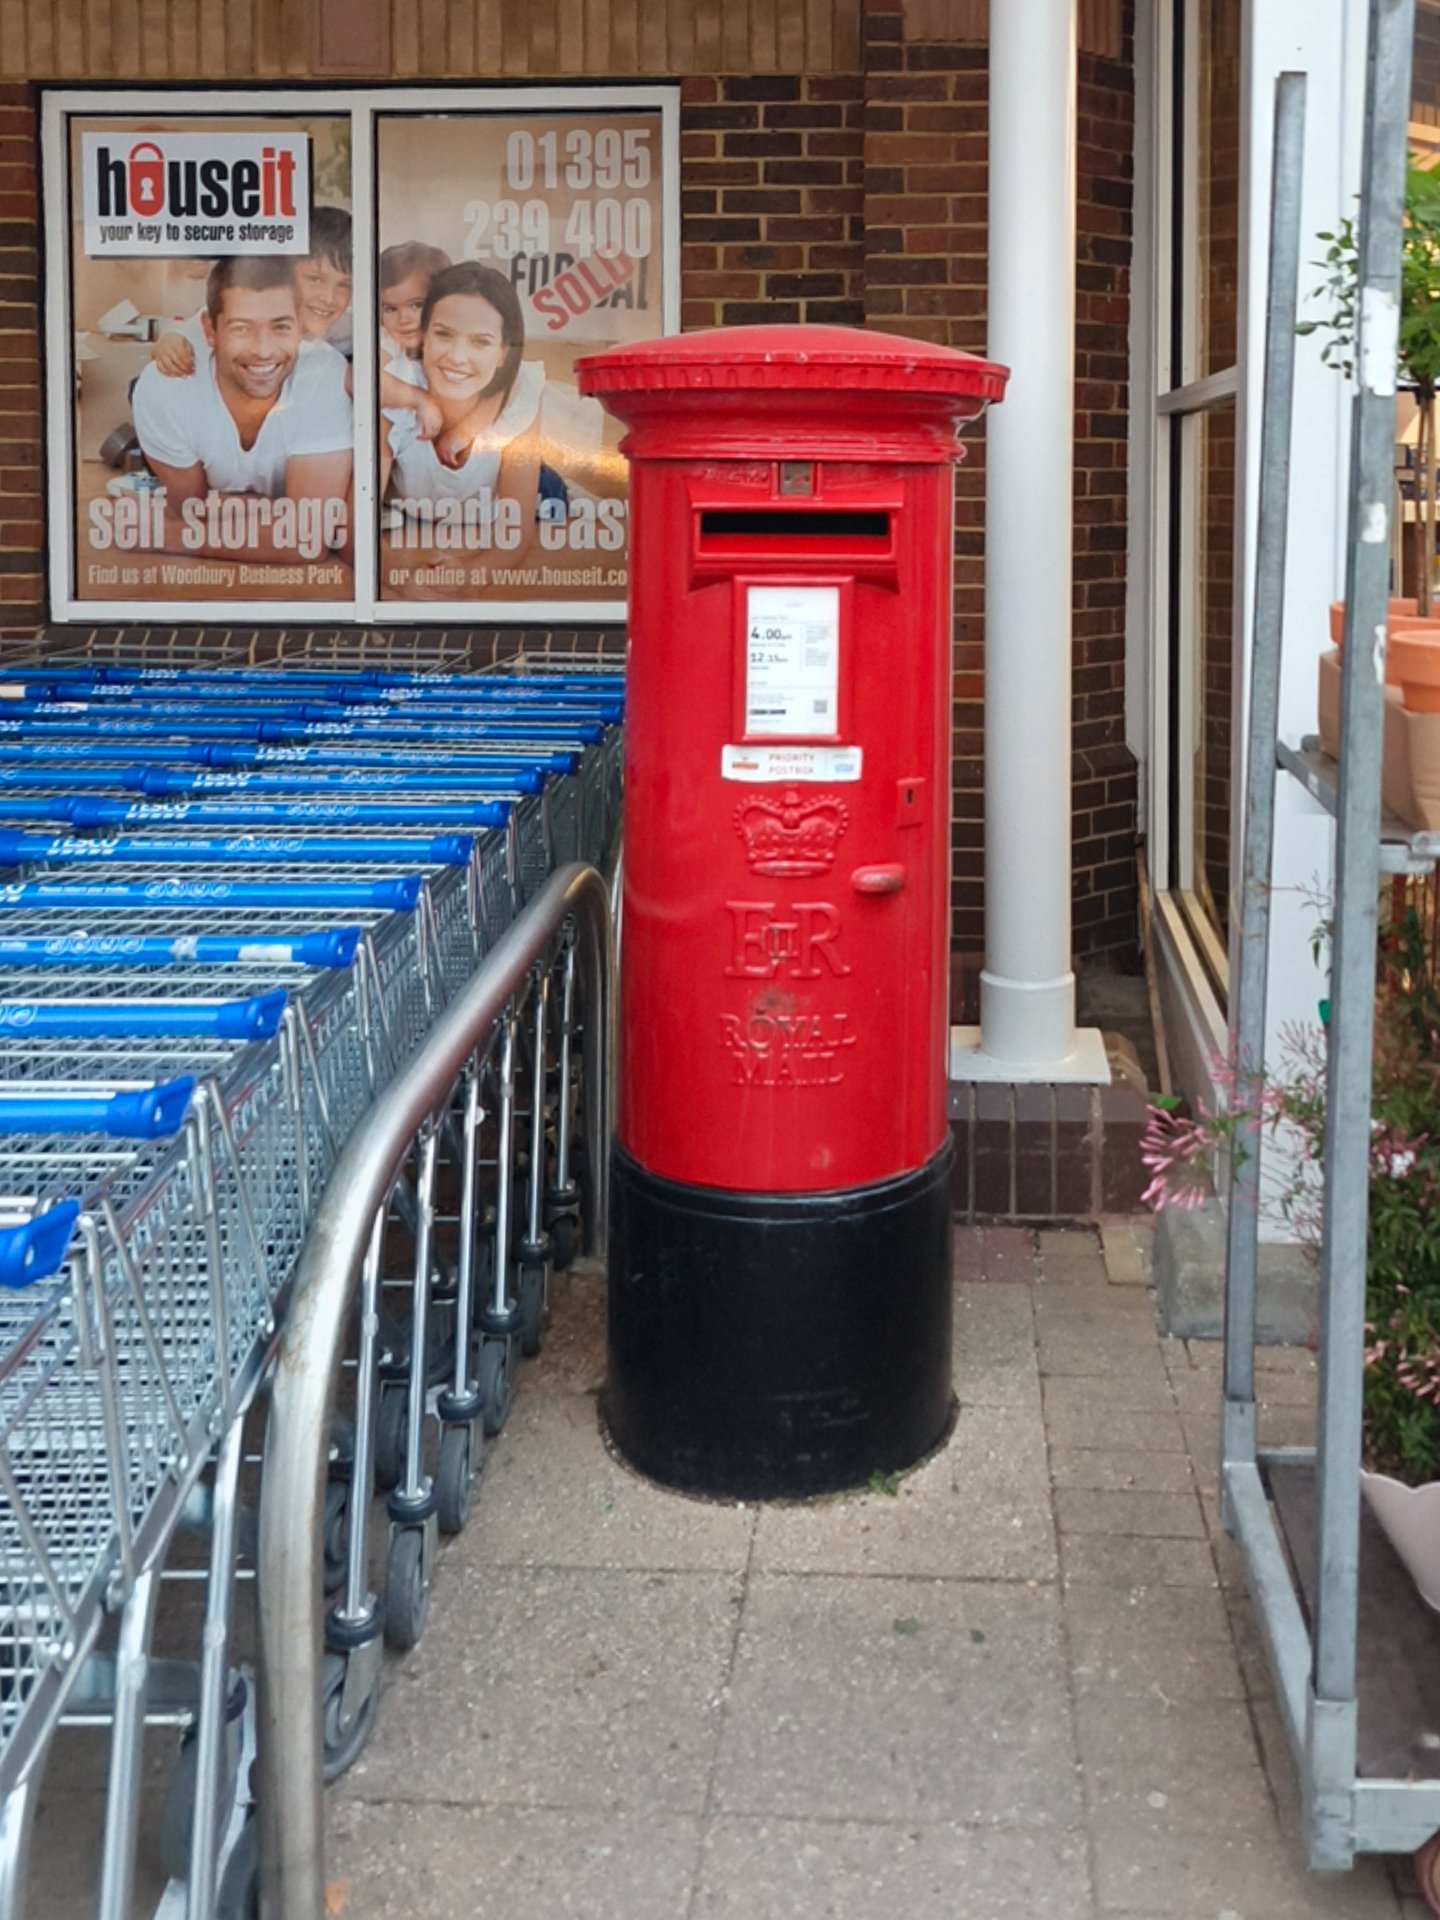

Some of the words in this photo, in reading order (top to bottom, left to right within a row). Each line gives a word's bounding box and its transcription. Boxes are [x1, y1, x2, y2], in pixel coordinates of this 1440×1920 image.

[97, 142, 296, 217] houseit
[507, 129, 650, 190] 01395
[100, 223, 132, 243] your
[137, 222, 161, 241] key
[166, 223, 179, 240] to
[184, 224, 234, 240] secure
[239, 223, 294, 243] storage
[462, 199, 549, 259] 239
[565, 198, 651, 258] 400
[531, 243, 635, 330] SOLD
[88, 486, 167, 549] self
[181, 490, 347, 559] storage
[389, 486, 521, 550] made
[538, 497, 629, 555] eas
[88, 565, 117, 585] Find
[122, 568, 139, 584] us
[143, 567, 157, 584] at
[161, 566, 235, 588] Woodbury
[239, 566, 304, 585] Business
[307, 566, 343, 585] Park
[389, 568, 409, 585] or
[415, 567, 465, 585] online
[470, 567, 487, 585] at
[720, 1013, 856, 1048] ROYAL
[731, 1051, 844, 1085] MAIL
